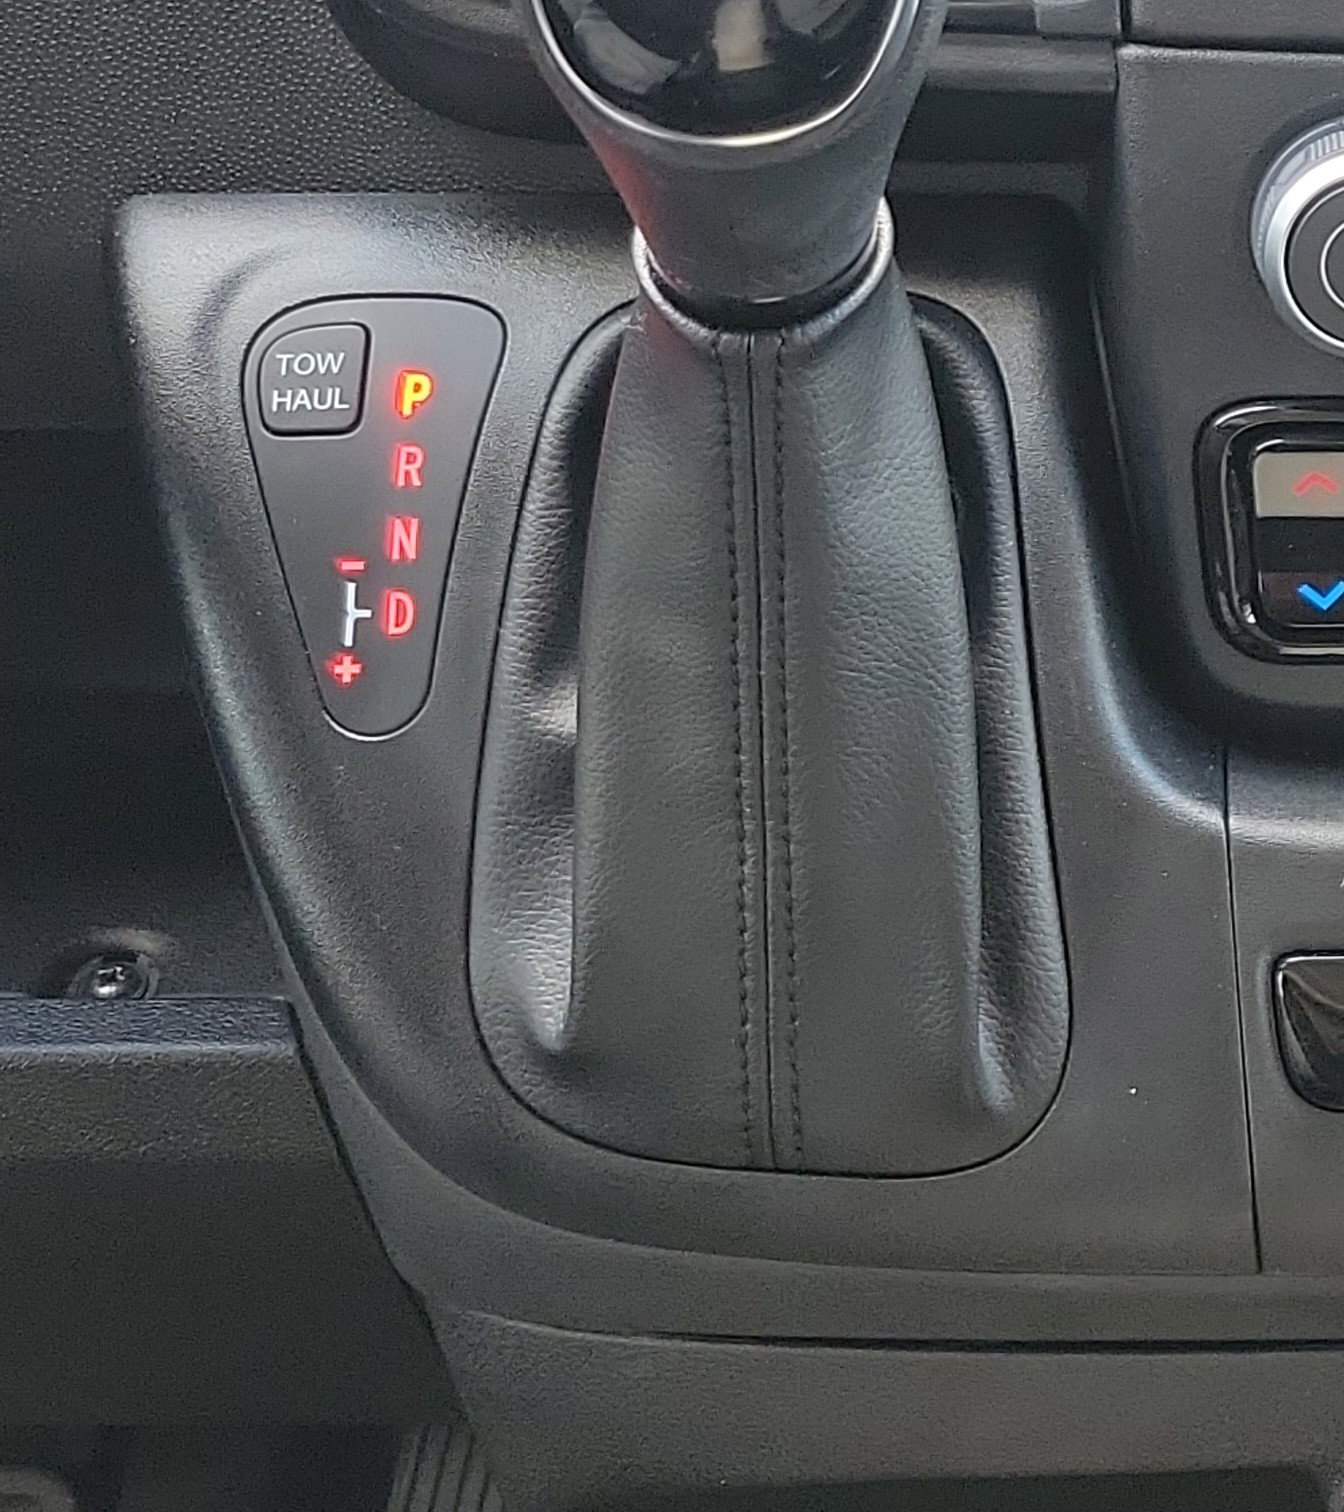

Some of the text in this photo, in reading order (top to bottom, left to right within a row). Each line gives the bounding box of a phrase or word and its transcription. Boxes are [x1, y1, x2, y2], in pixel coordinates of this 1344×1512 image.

[275, 351, 346, 376] TOW
[271, 387, 351, 413] HAUL
[395, 369, 433, 419] P
[395, 443, 425, 488] R
[389, 516, 420, 562] N
[386, 589, 416, 638] D
